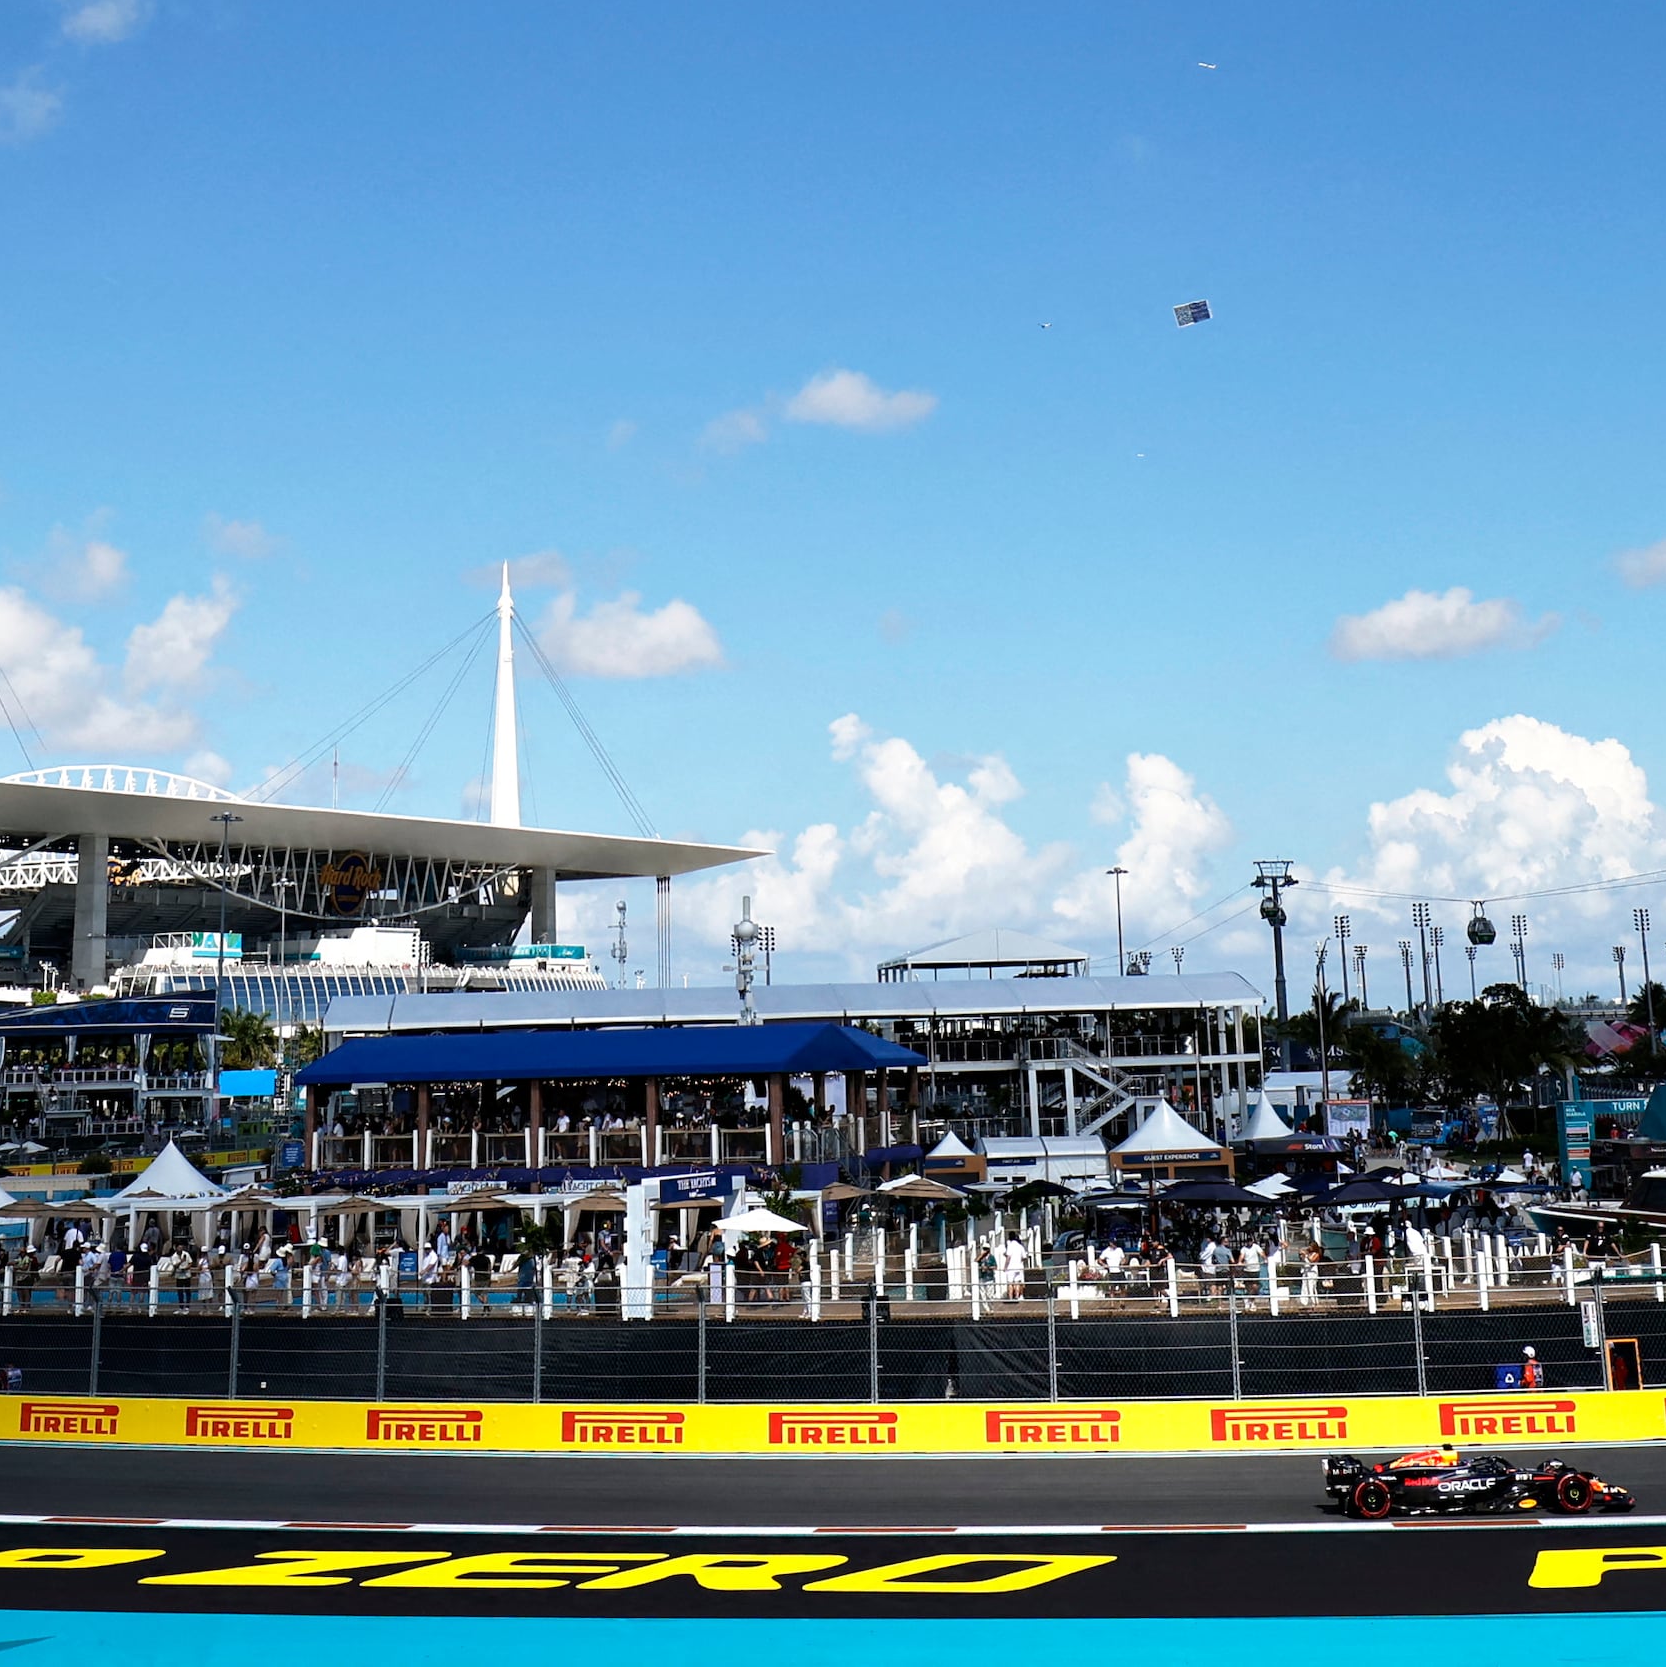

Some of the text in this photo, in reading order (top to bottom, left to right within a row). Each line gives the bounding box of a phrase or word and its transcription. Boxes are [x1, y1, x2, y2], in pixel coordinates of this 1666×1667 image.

[319, 864, 353, 888] Hard
[1612, 1102, 1641, 1110] TURN
[1143, 1154, 1163, 1162] GUEST
[20, 1402, 120, 1435] PIRELLI
[185, 1406, 295, 1439] PIRELLI
[367, 1409, 484, 1442] PIRELLI
[561, 1411, 685, 1444] PIRELLI
[768, 1412, 898, 1444] PIRELLI
[985, 1410, 1121, 1443] PIRELLI
[1211, 1406, 1348, 1442] PIRELLI
[1439, 1400, 1576, 1436] PIRELLI
[1437, 1478, 1496, 1492] ORACLE
[137, 1550, 1118, 1592] ZERO
